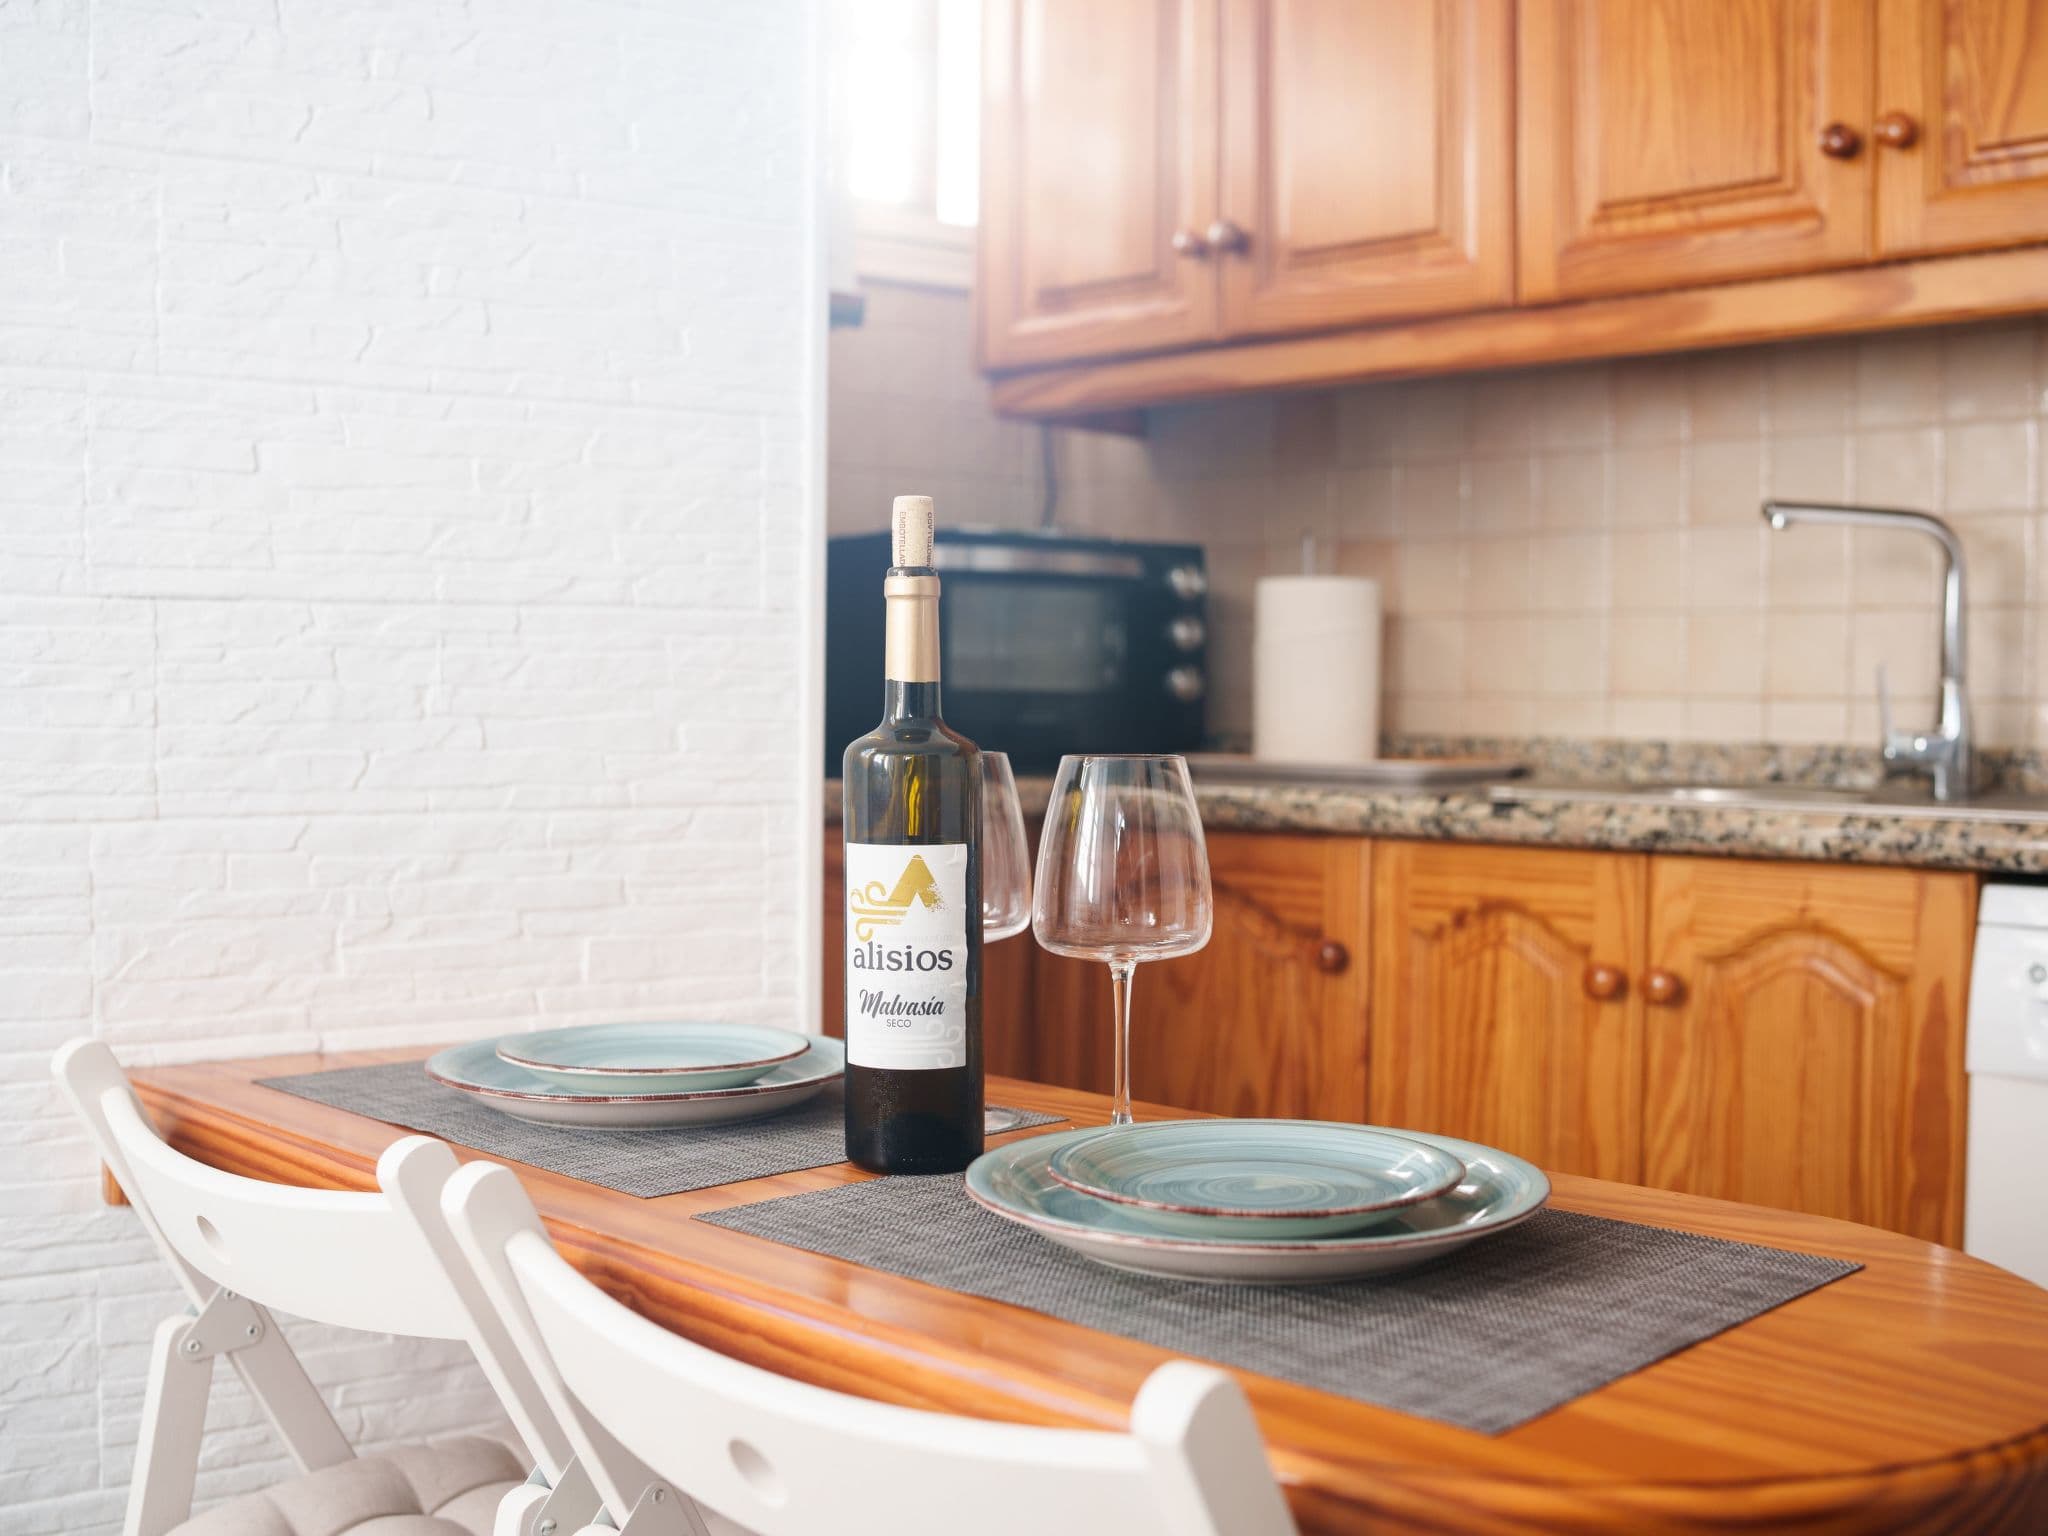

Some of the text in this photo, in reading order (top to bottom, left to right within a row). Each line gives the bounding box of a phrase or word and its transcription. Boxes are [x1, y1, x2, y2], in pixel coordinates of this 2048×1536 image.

[853, 940, 953, 972] alisios
[859, 989, 946, 1019] Malvasía
[886, 1018, 912, 1028] SECO
